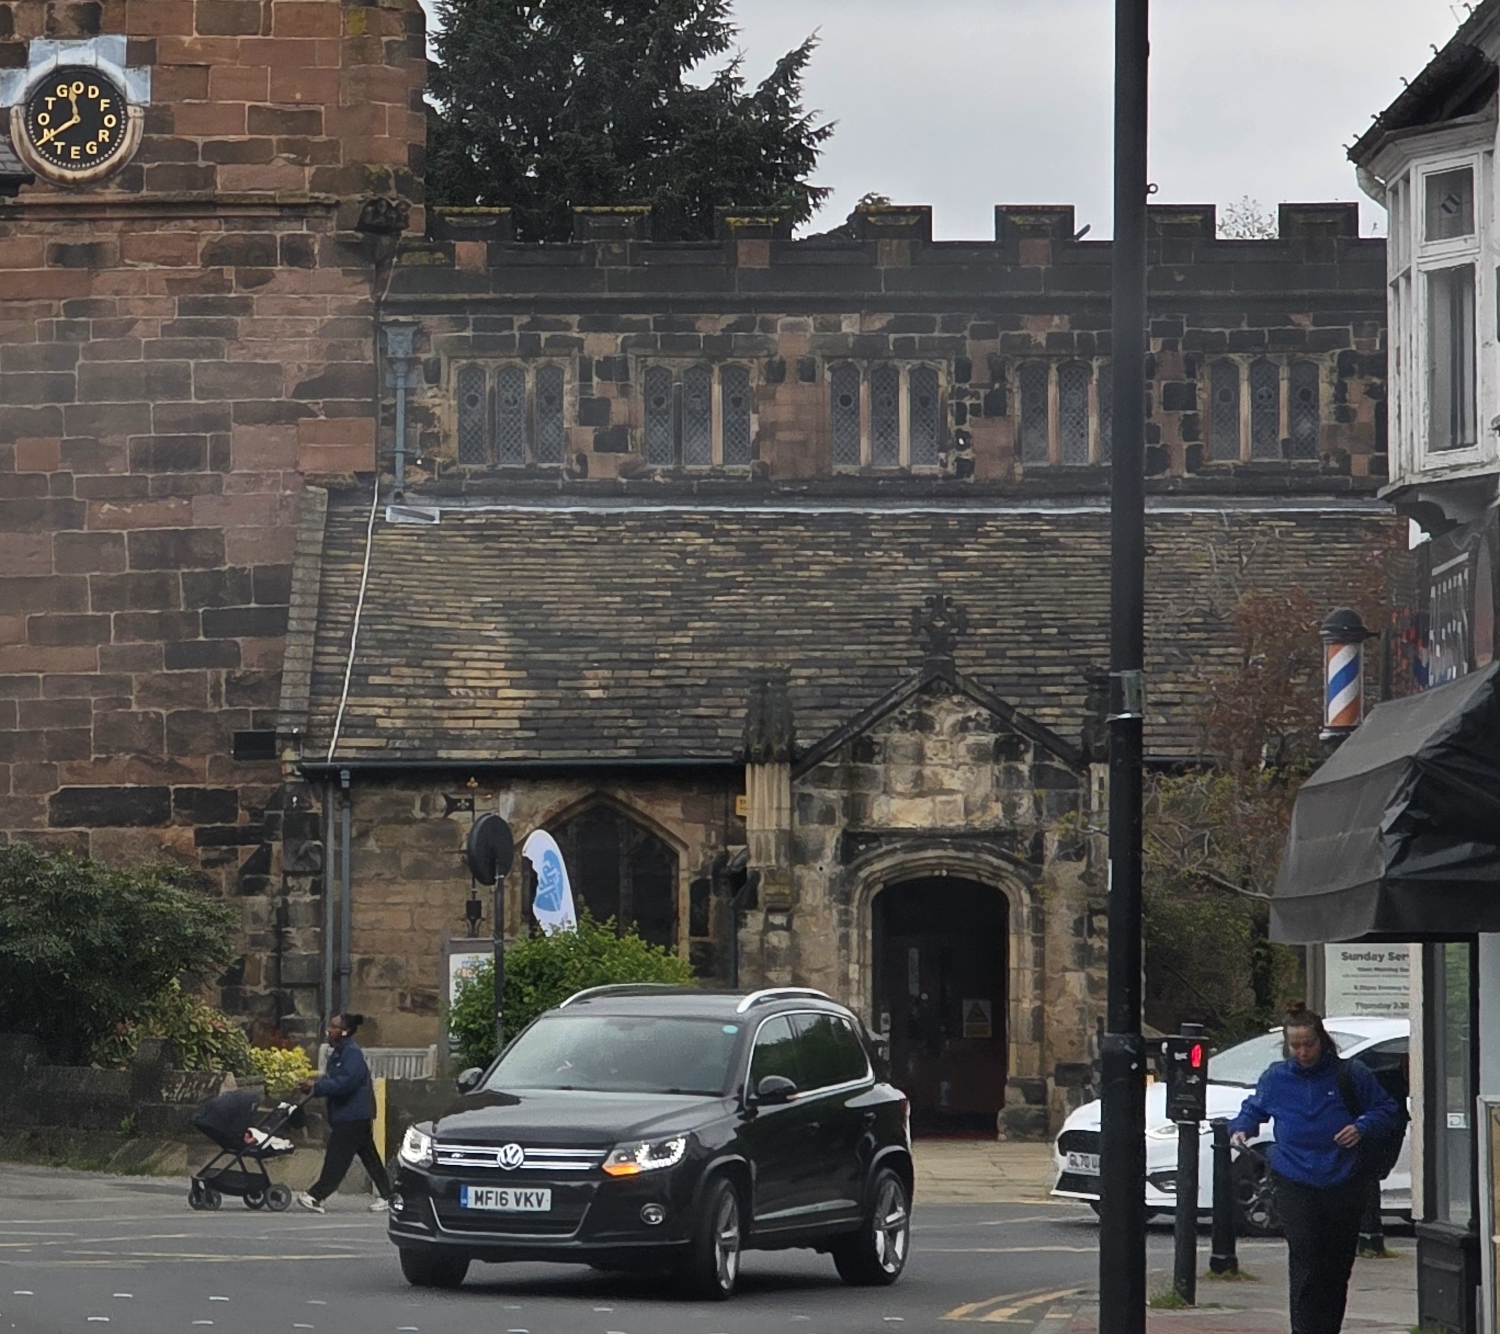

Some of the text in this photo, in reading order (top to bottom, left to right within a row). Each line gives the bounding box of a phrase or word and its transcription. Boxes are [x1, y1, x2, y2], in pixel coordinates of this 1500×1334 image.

[56, 81, 100, 99] GOD
[53, 98, 117, 159] FORGET
[1341, 951, 1409, 962] Sunday Ser
[474, 1190, 545, 1208] MF16 VKV
